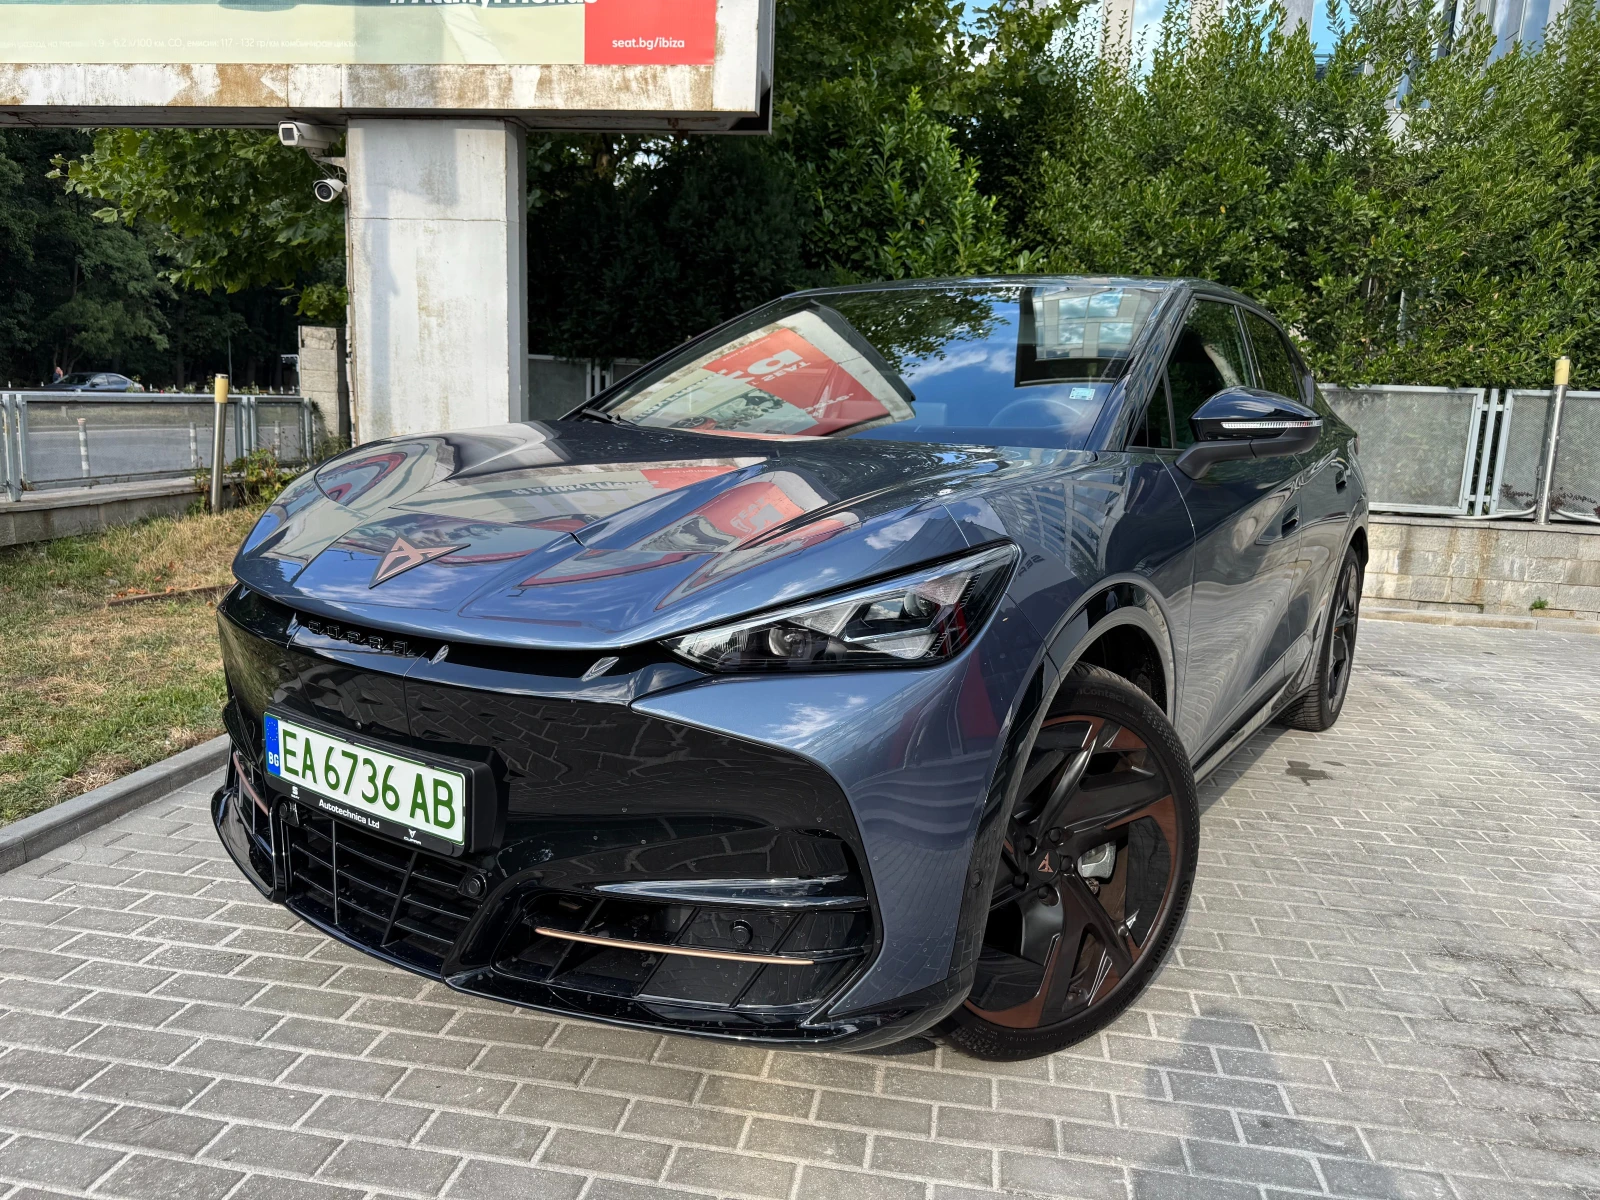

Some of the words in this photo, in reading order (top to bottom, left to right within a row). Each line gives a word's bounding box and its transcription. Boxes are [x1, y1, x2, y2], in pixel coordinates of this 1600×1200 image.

[221, 38, 233, 48] 117
[241, 38, 254, 48] 132
[612, 37, 685, 50] seat.bg/ibiza
[268, 751, 280, 767] BG
[282, 728, 318, 785] EA
[324, 746, 401, 812] 6736
[409, 772, 456, 830] AB
[319, 799, 367, 823] Autotechnica
[368, 818, 380, 829] Ltd
